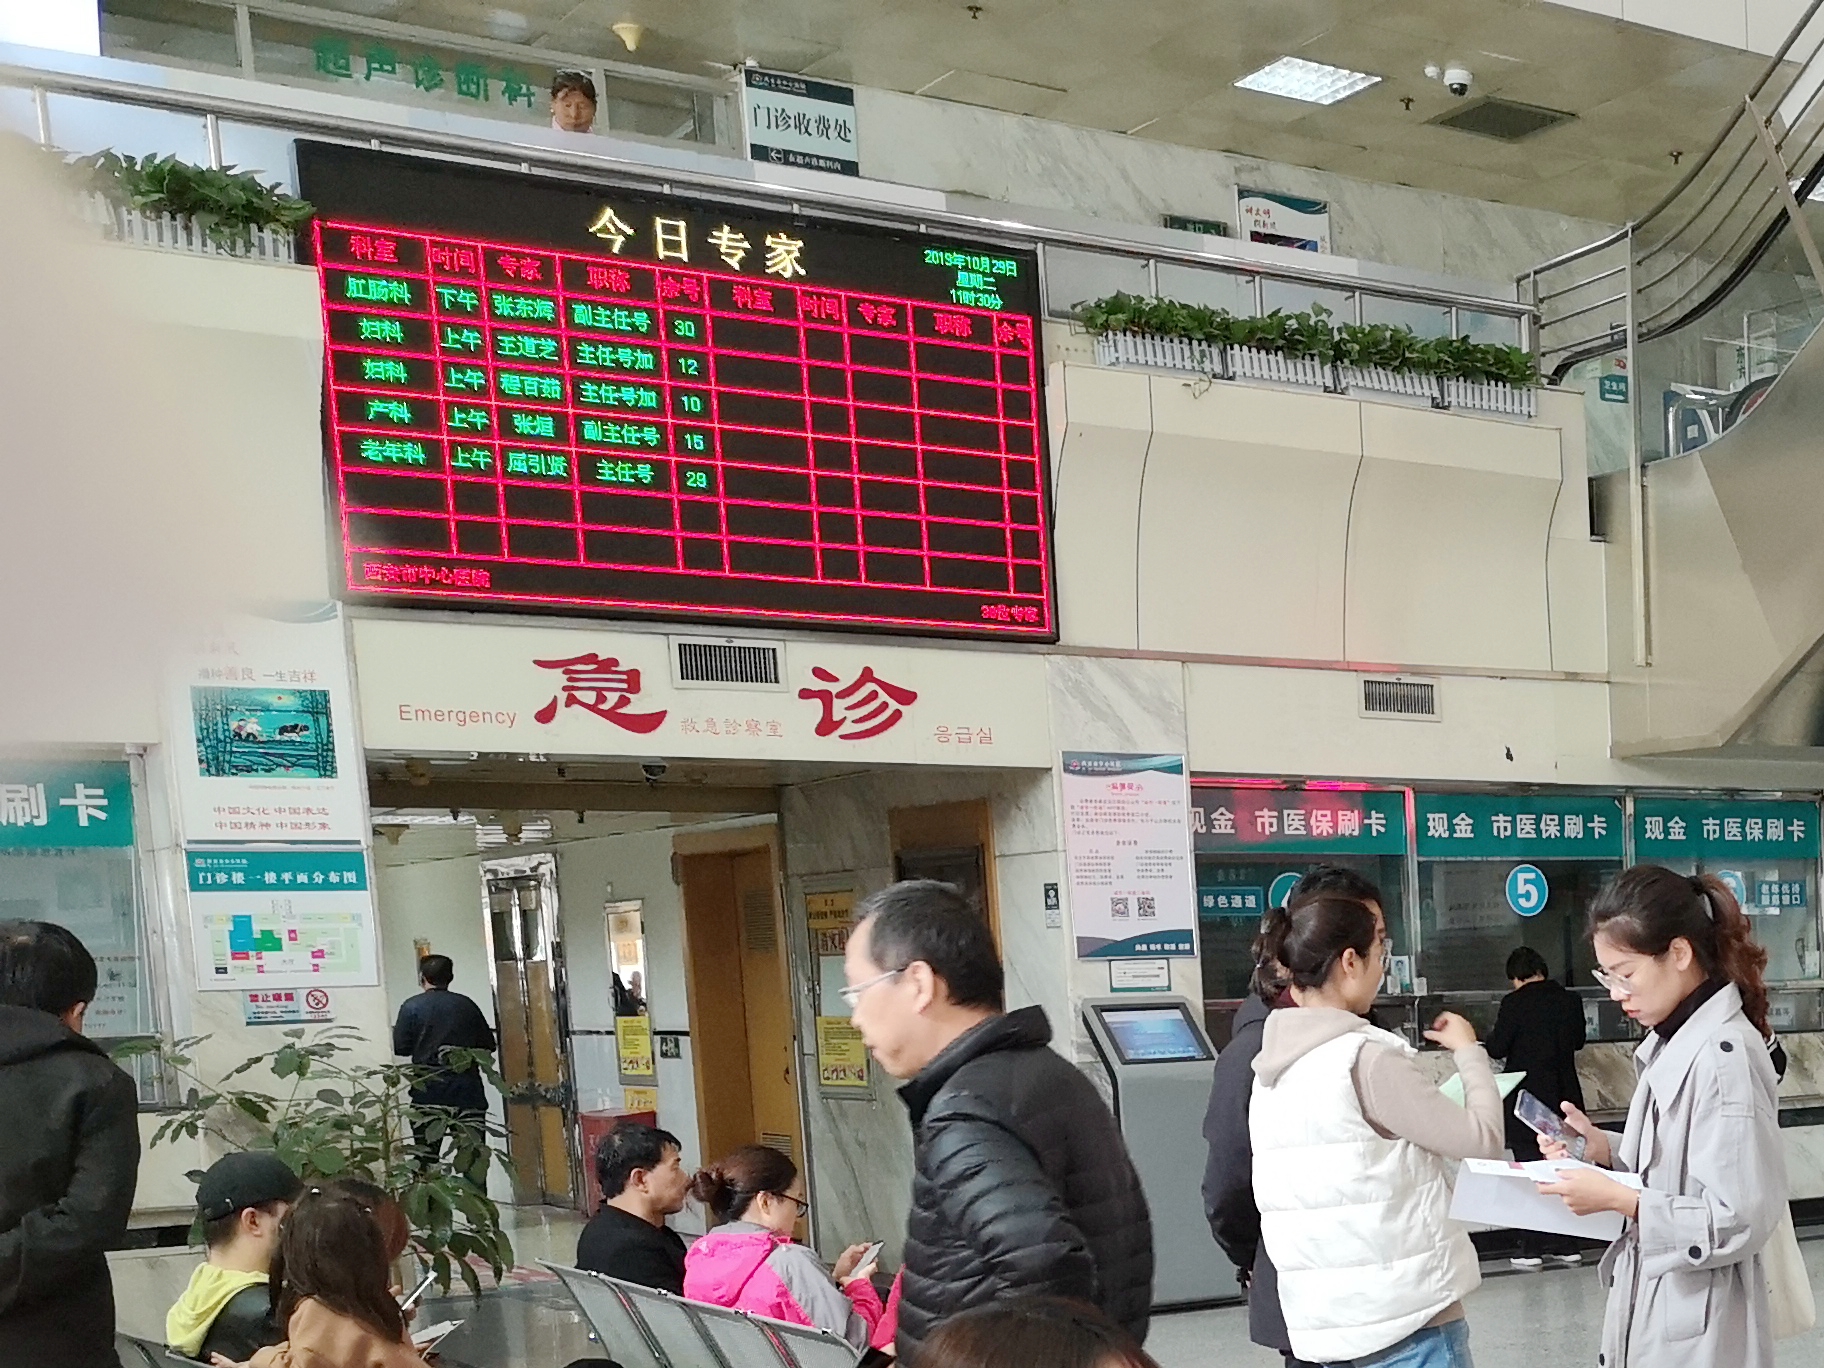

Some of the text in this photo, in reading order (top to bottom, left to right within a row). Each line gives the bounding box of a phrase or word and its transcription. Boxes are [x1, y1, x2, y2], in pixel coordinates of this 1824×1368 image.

[753, 102, 852, 143] 门诊收费处
[588, 206, 807, 279] 今日专家
[924, 249, 1018, 277] 2019年10月29日
[350, 235, 398, 263] 科室
[432, 247, 476, 274] 时间
[497, 255, 543, 281] 专家
[586, 264, 631, 293] 职称
[733, 285, 774, 312] 科室
[802, 295, 841, 321] 时间
[857, 302, 896, 328] 专家
[933, 312, 972, 338] 职称
[956, 271, 996, 291] 星期二
[346, 276, 411, 305] 肛肠科
[436, 287, 478, 312] 下午
[572, 303, 651, 333] 副主任号
[674, 320, 695, 338] 30
[950, 289, 1003, 310] 11时30分
[359, 317, 699, 376] 妇科 上午 王道芝 主任号加 12
[363, 358, 407, 384] 妇科
[445, 367, 486, 391] 上午
[580, 381, 658, 409] 主任号加
[681, 395, 702, 413] 10
[367, 398, 412, 425] 产科
[448, 407, 490, 431] 上午
[581, 419, 660, 448] 副主任号
[685, 433, 705, 451] 15
[361, 439, 426, 466] 老年科
[452, 447, 493, 471] 上午
[595, 459, 655, 485] 主任号
[687, 471, 706, 489] 29
[262, 669, 317, 684] 一生吉祥
[400, 703, 517, 730] Emergency
[933, 724, 994, 745] 응급실
[0, 782, 108, 827] 刷卡
[213, 805, 270, 816] 中国文化
[1255, 808, 1387, 837] 市医保刷卡
[1427, 812, 1608, 839] 现金 市医保刷卡
[1645, 814, 1806, 842] 现金 市医保刷卡
[198, 871, 358, 885] 门诊楼一楼平面分布图
[1517, 873, 1538, 908] 5
[1203, 894, 1257, 908] 绿色通道
